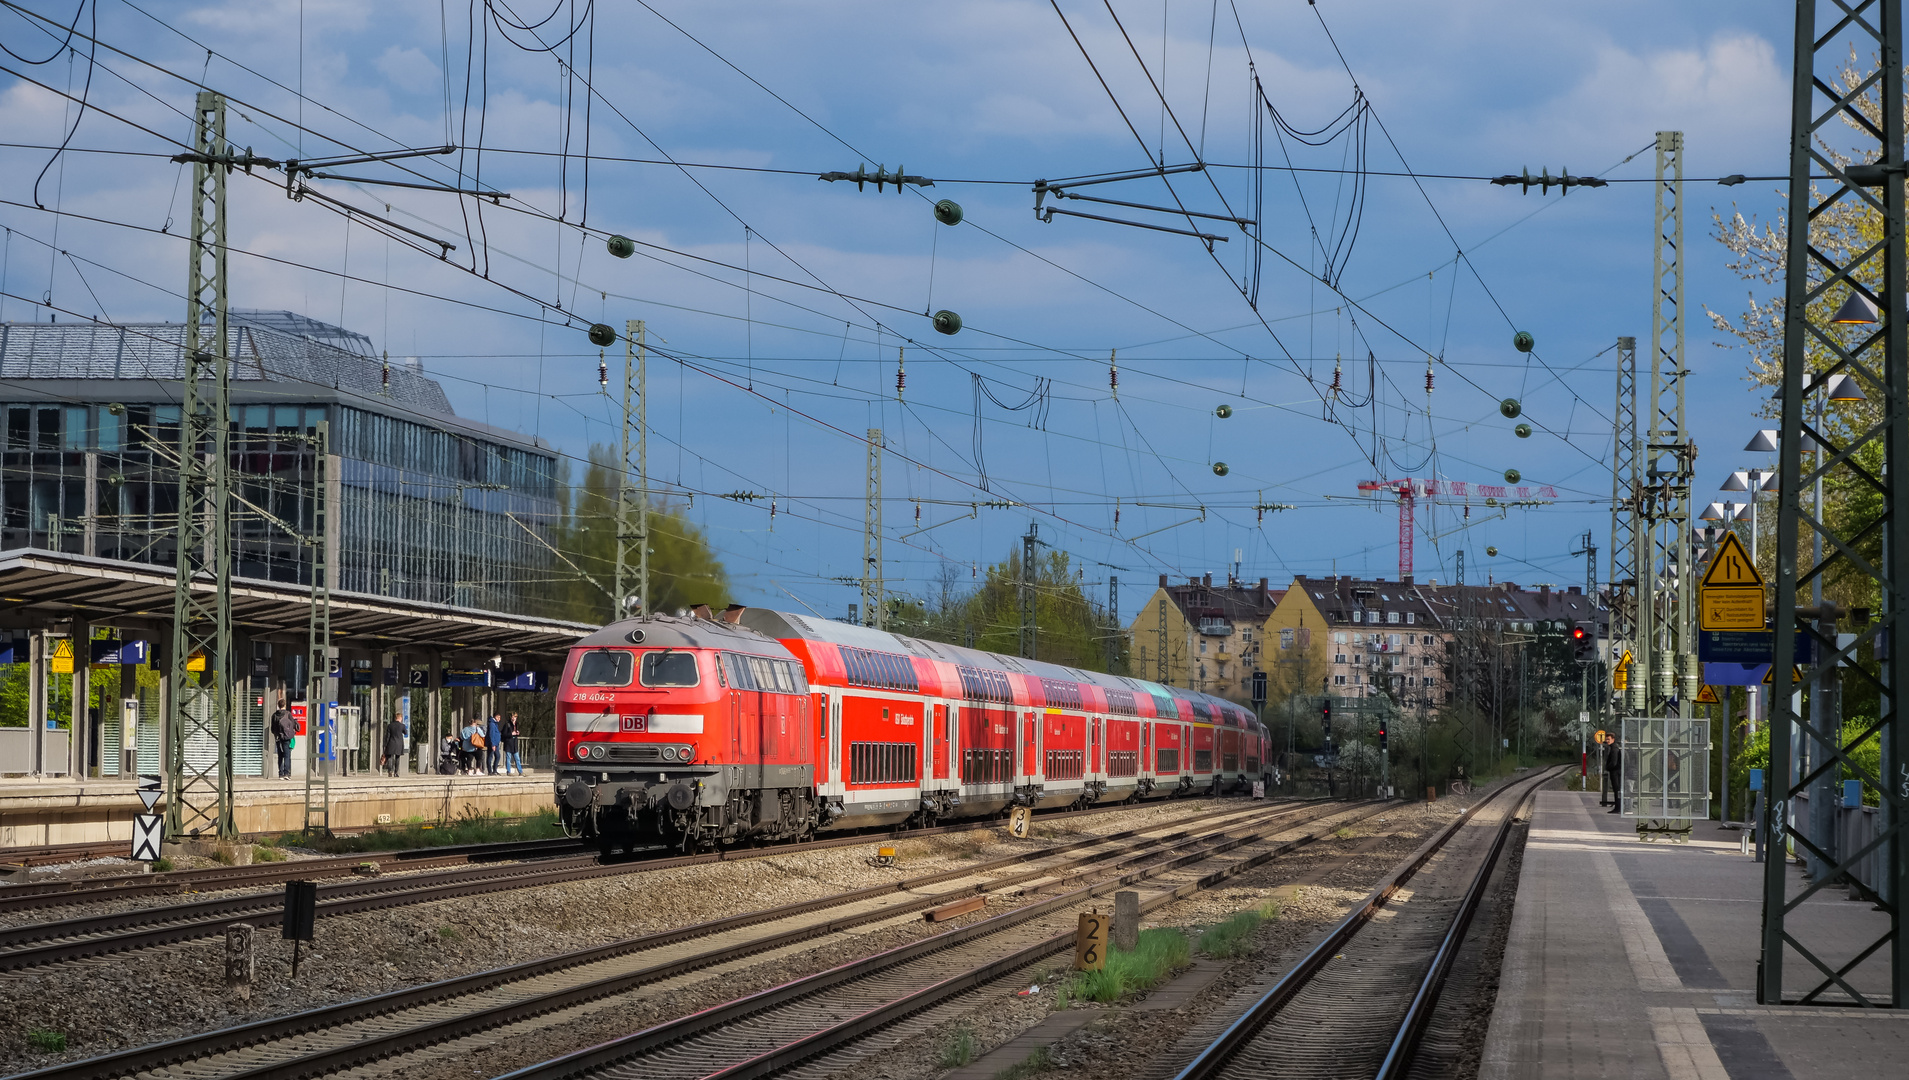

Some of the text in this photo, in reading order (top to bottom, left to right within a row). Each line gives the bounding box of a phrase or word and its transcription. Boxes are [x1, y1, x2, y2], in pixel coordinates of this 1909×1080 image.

[134, 640, 143, 659] 1
[328, 658, 339, 674] B
[413, 671, 422, 684] 2
[526, 671, 534, 686] 1
[572, 693, 615, 701] 218 404-2
[624, 717, 644, 730] DB
[378, 815, 390, 823] 492
[1016, 807, 1026, 821] 3
[1014, 822, 1023, 834] 4
[1086, 918, 1100, 940] 2
[232, 933, 245, 953] 3
[1083, 943, 1098, 965] 6
